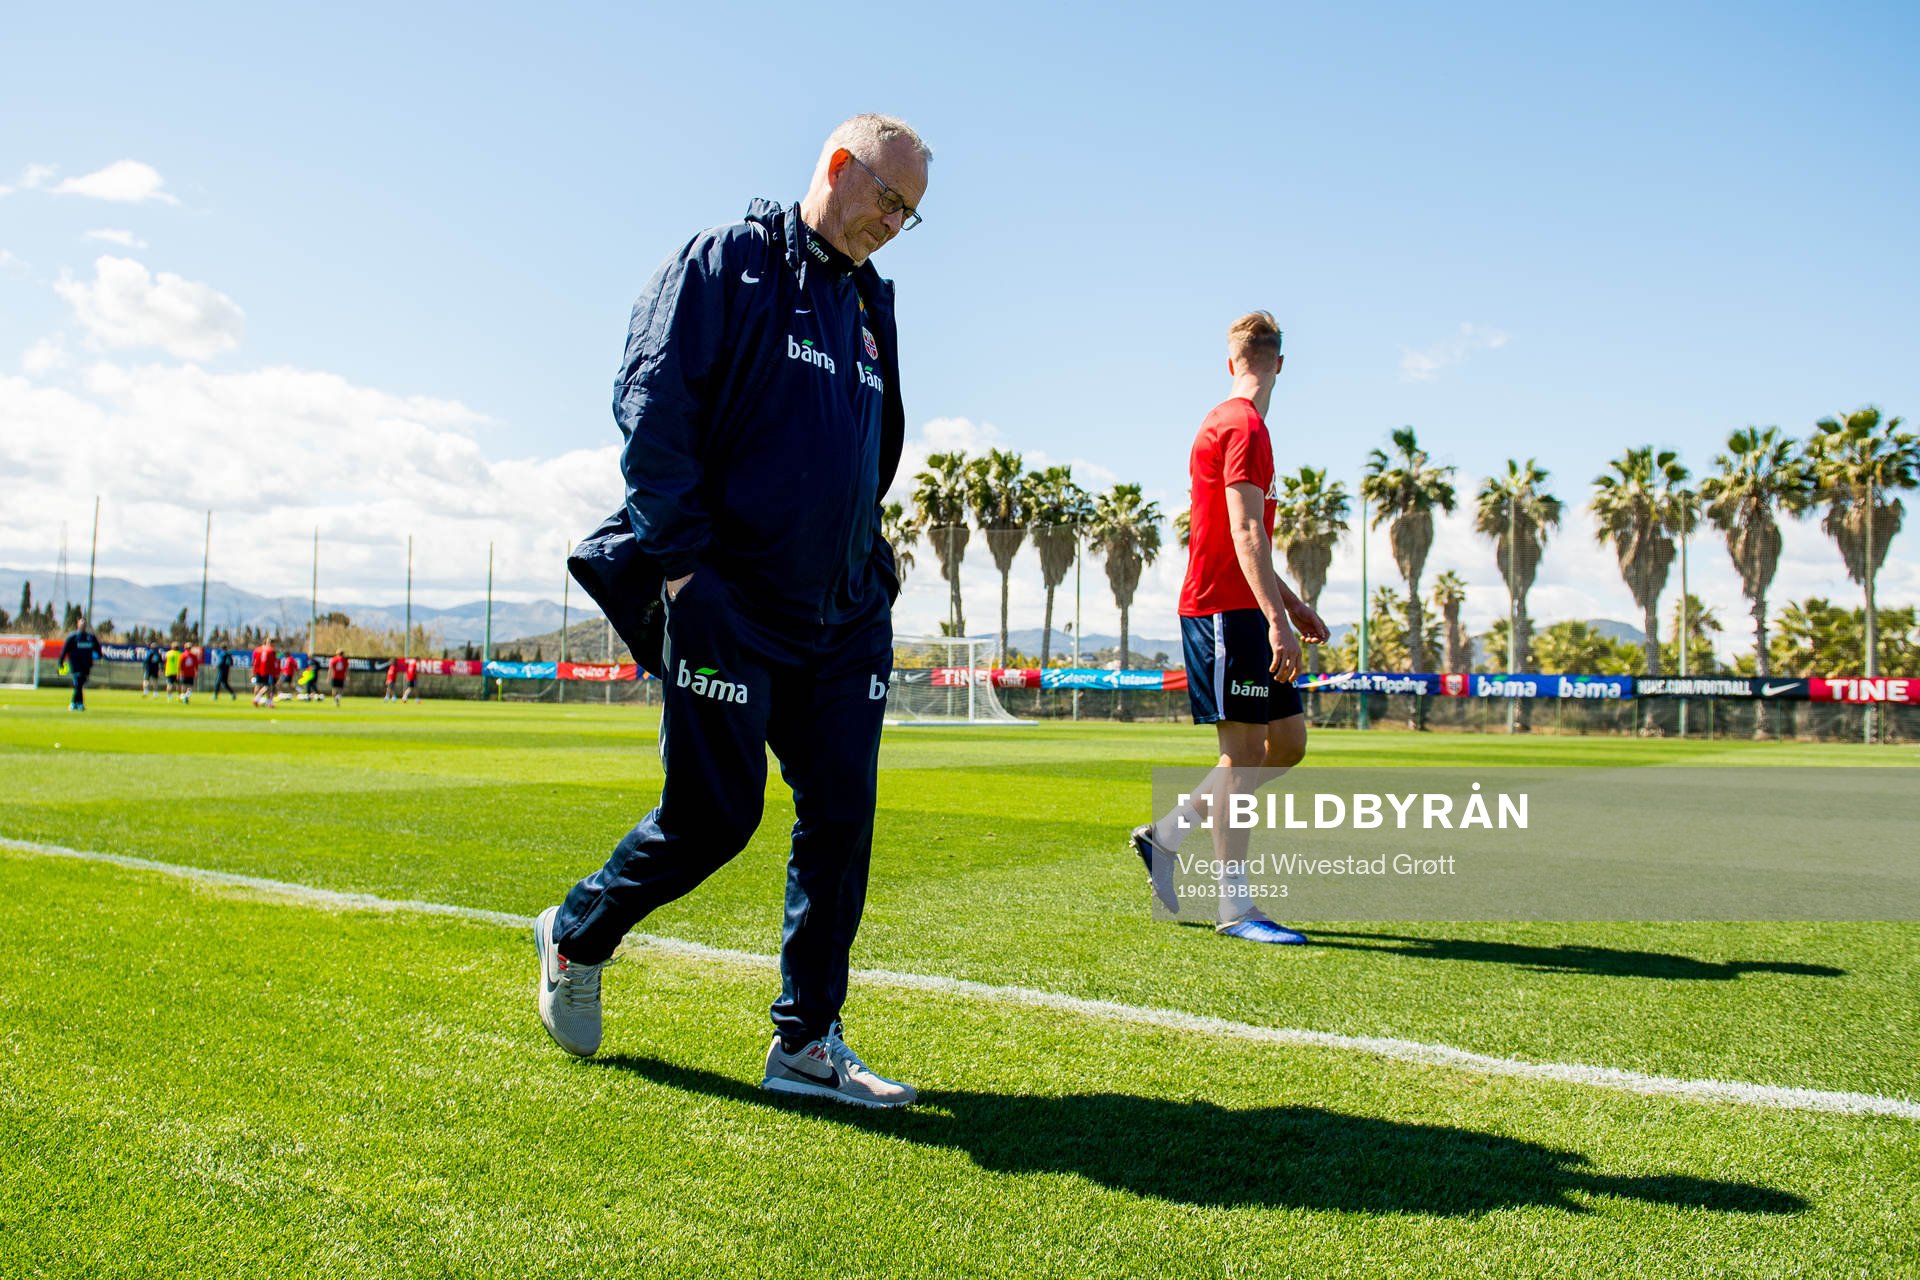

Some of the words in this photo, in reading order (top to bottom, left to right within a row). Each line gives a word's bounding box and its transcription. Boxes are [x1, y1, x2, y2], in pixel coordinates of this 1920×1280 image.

[787, 334, 836, 374] bama
[856, 361, 884, 395] bam
[676, 659, 749, 704] bama
[1231, 680, 1269, 698] bama
[1372, 675, 1428, 695] Tipping
[1477, 675, 1537, 698] bama
[1558, 676, 1621, 699] bama
[1825, 679, 1910, 701] TINE
